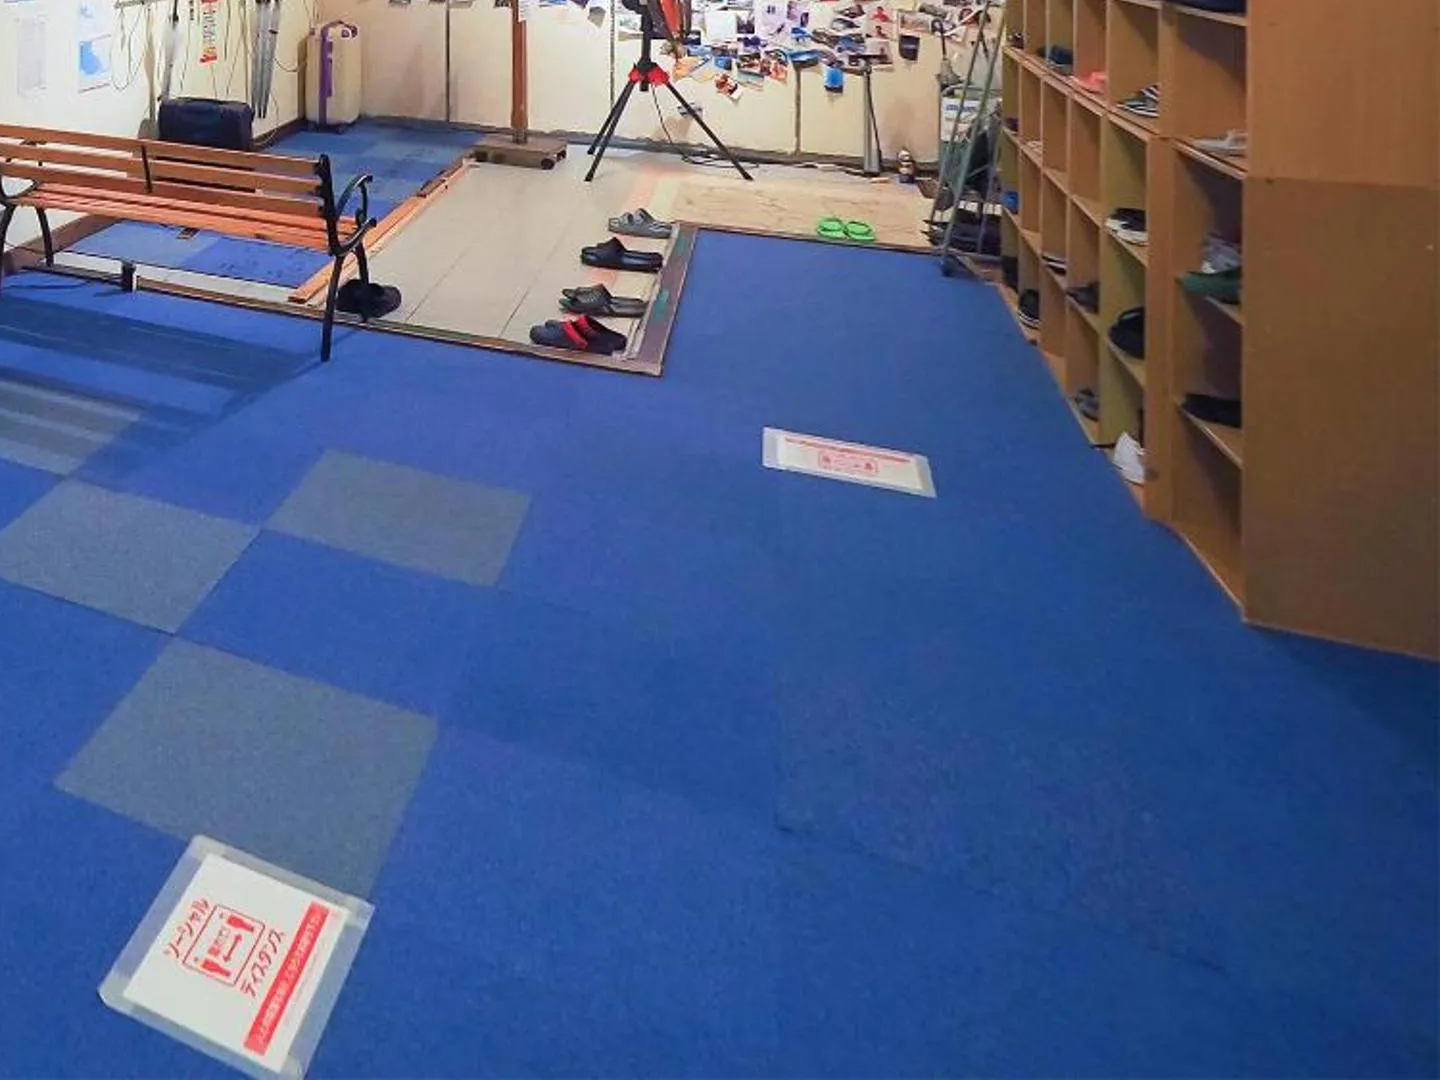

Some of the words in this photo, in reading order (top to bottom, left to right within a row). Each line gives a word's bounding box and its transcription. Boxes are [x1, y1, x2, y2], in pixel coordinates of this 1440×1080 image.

[163, 898, 210, 959] ソーシャル
[240, 929, 286, 998] ディスタンス
